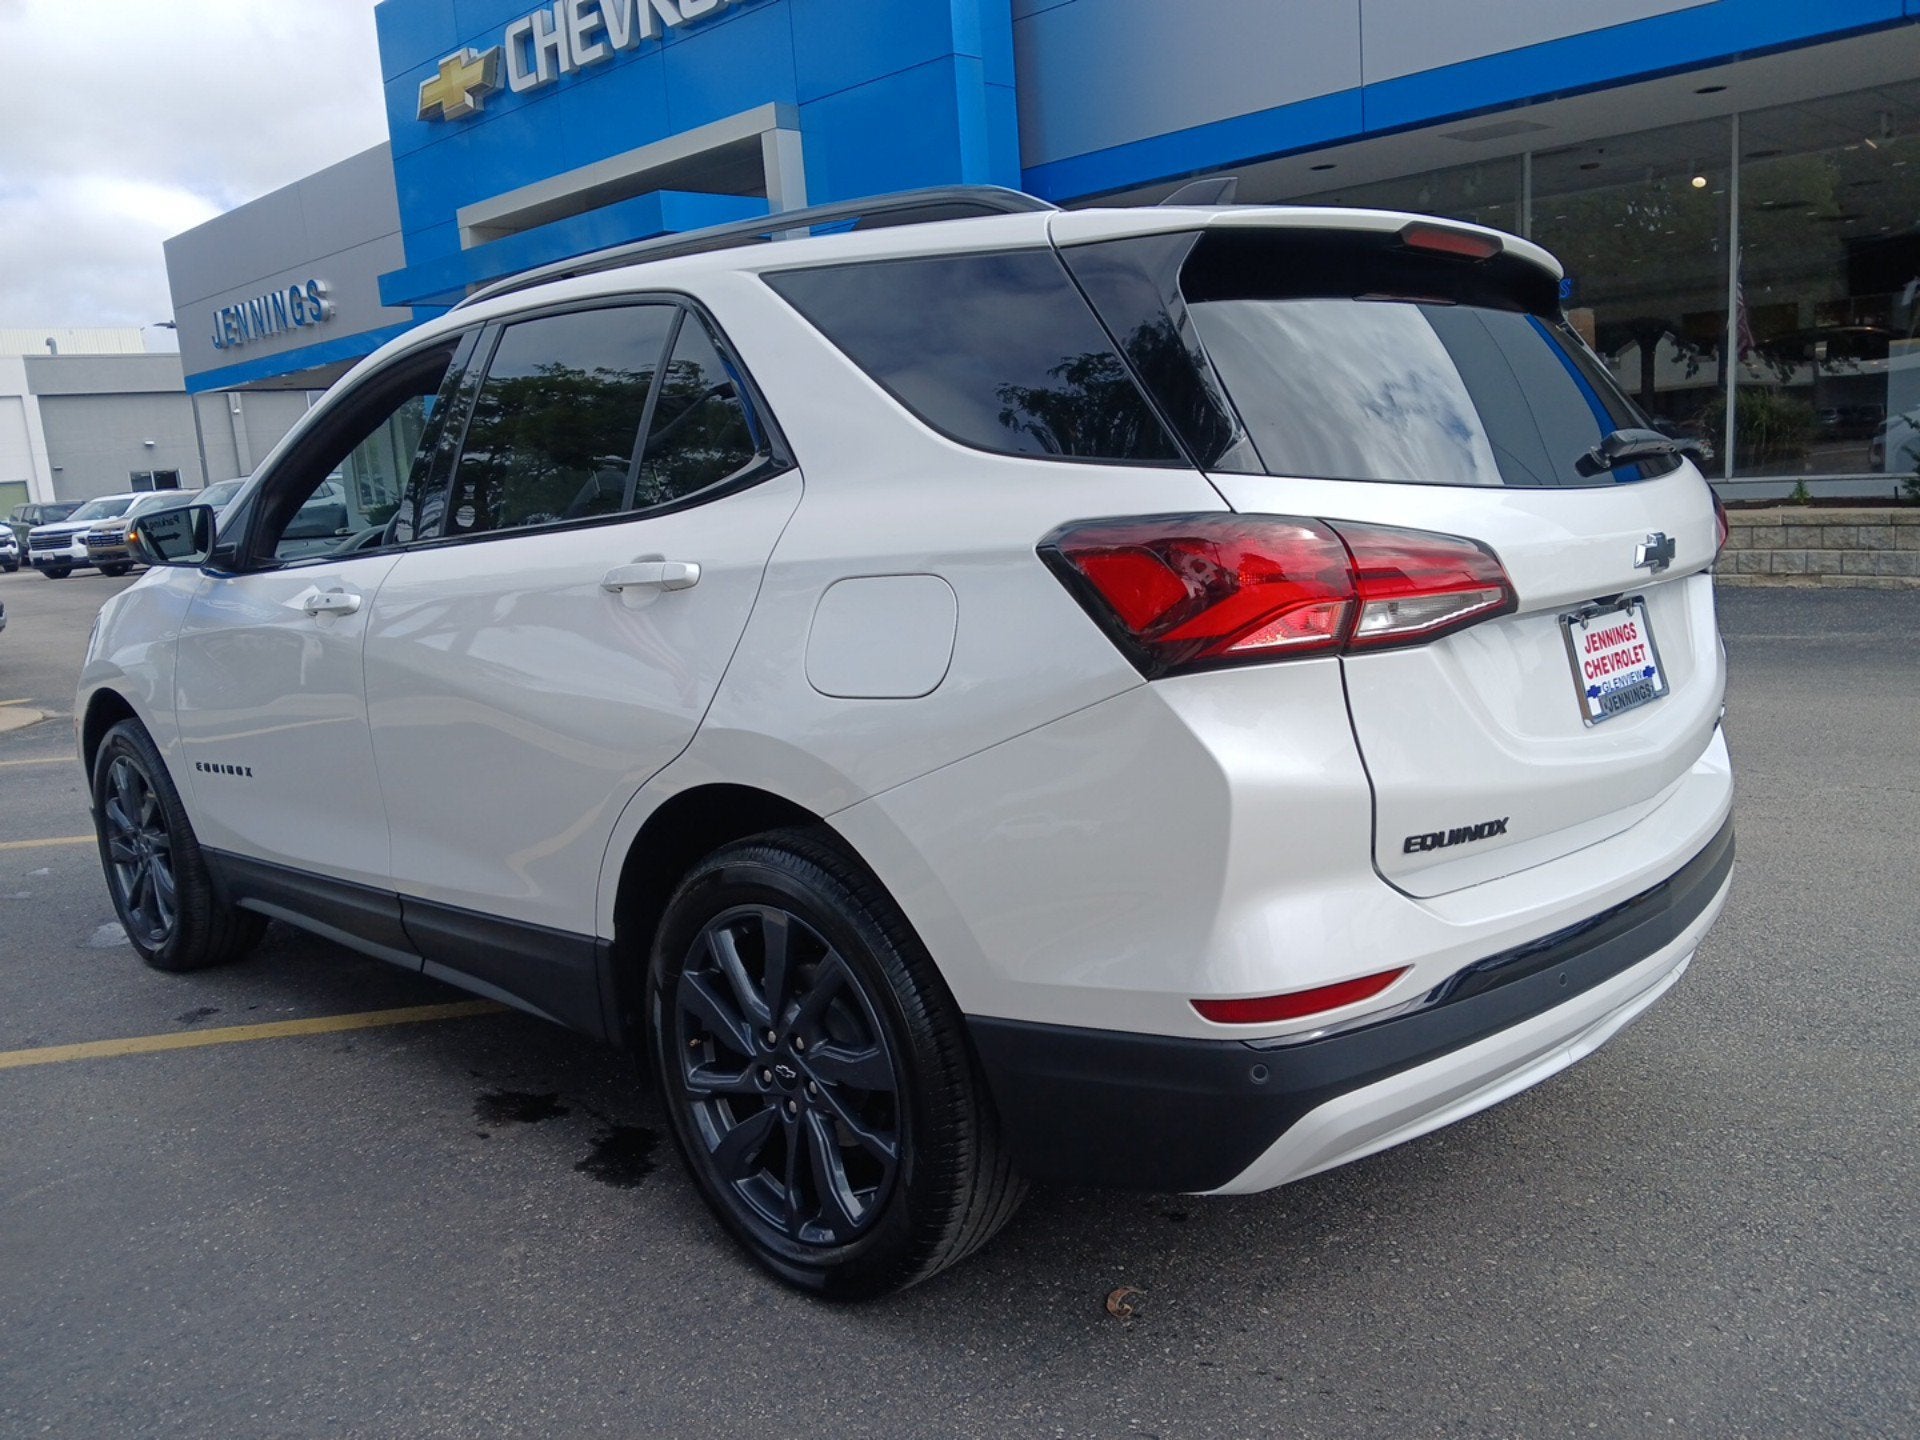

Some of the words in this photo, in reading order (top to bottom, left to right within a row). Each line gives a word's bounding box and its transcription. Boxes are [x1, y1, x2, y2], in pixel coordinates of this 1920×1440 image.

[212, 279, 330, 350] JENNINGS
[1584, 622, 1637, 653] JENNINGS
[1584, 644, 1646, 679] CHEVROLET
[1601, 670, 1642, 692] GLENVIEW
[1607, 684, 1651, 712] JENNINGS
[195, 761, 253, 778] EQUINOX
[1403, 816, 1510, 854] EQUINOX
